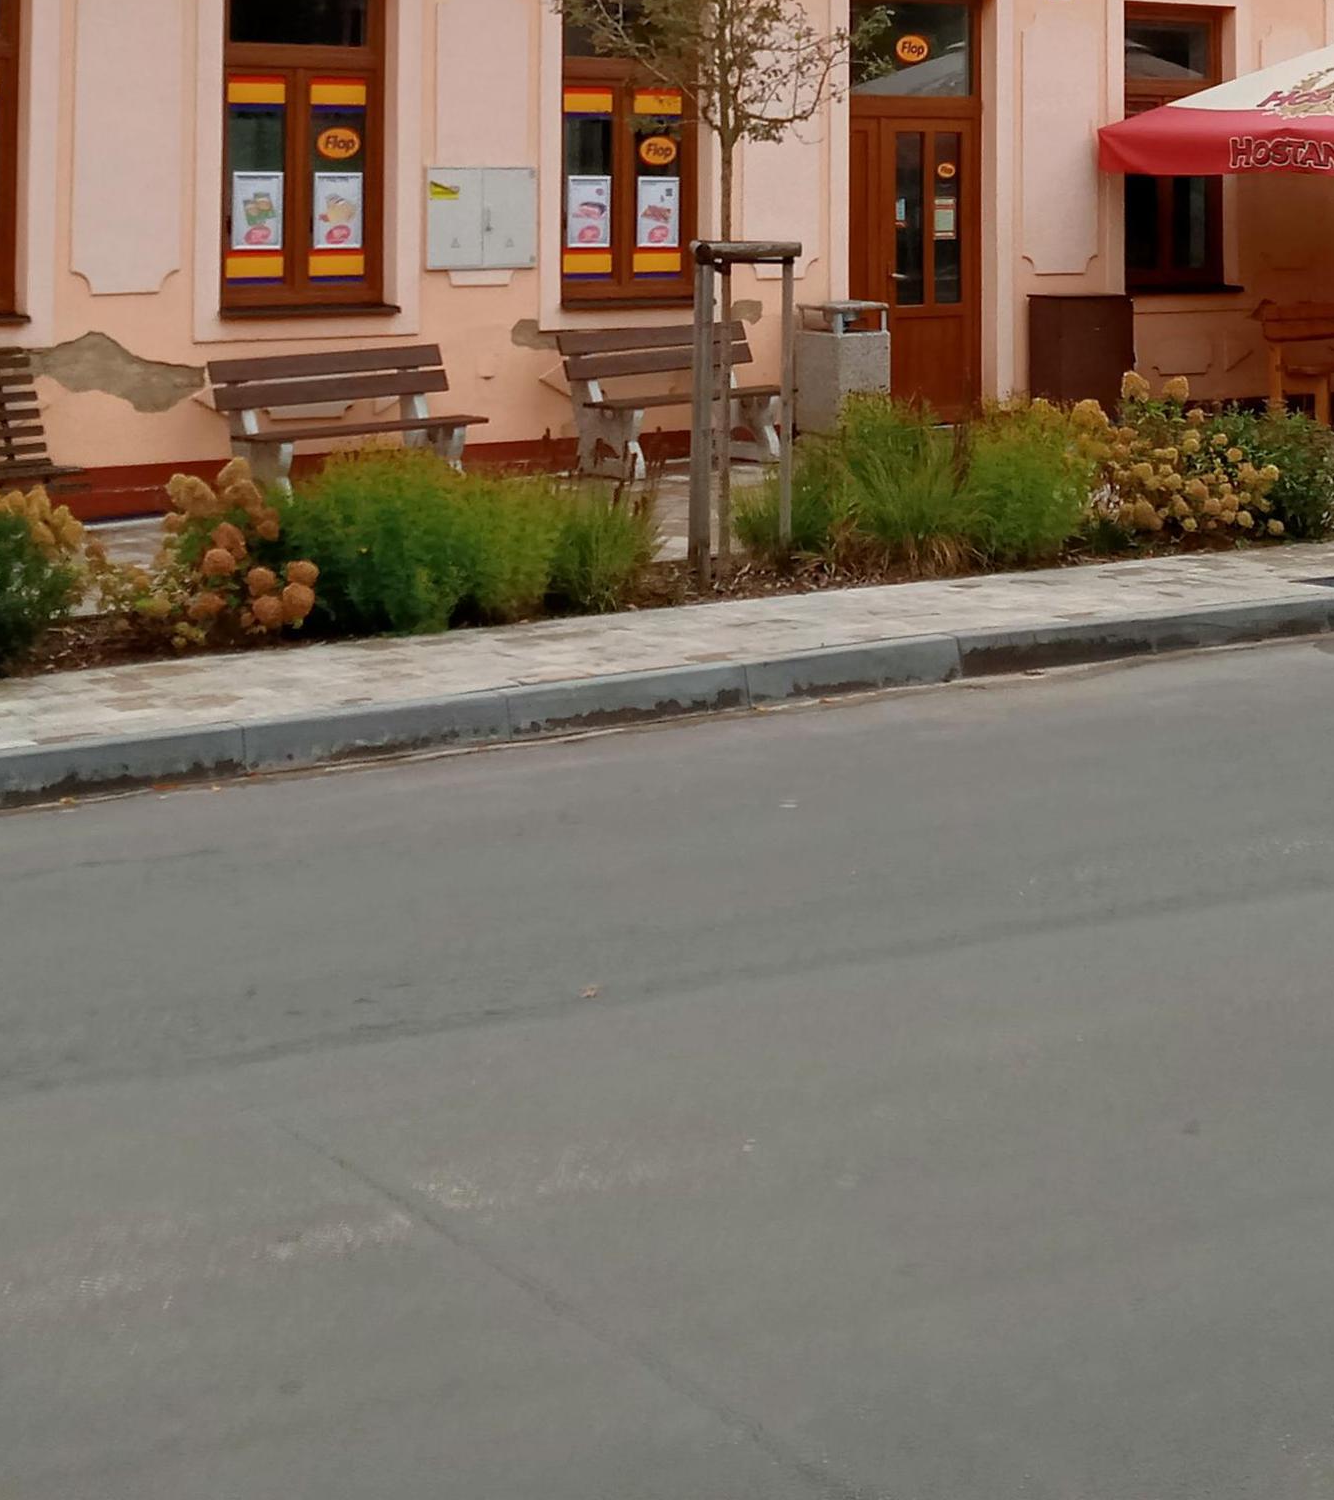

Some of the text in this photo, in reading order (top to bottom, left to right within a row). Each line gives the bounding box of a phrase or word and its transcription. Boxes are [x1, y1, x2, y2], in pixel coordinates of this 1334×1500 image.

[901, 40, 924, 55] Flop
[325, 135, 355, 152] Flop
[646, 142, 672, 158] Flop
